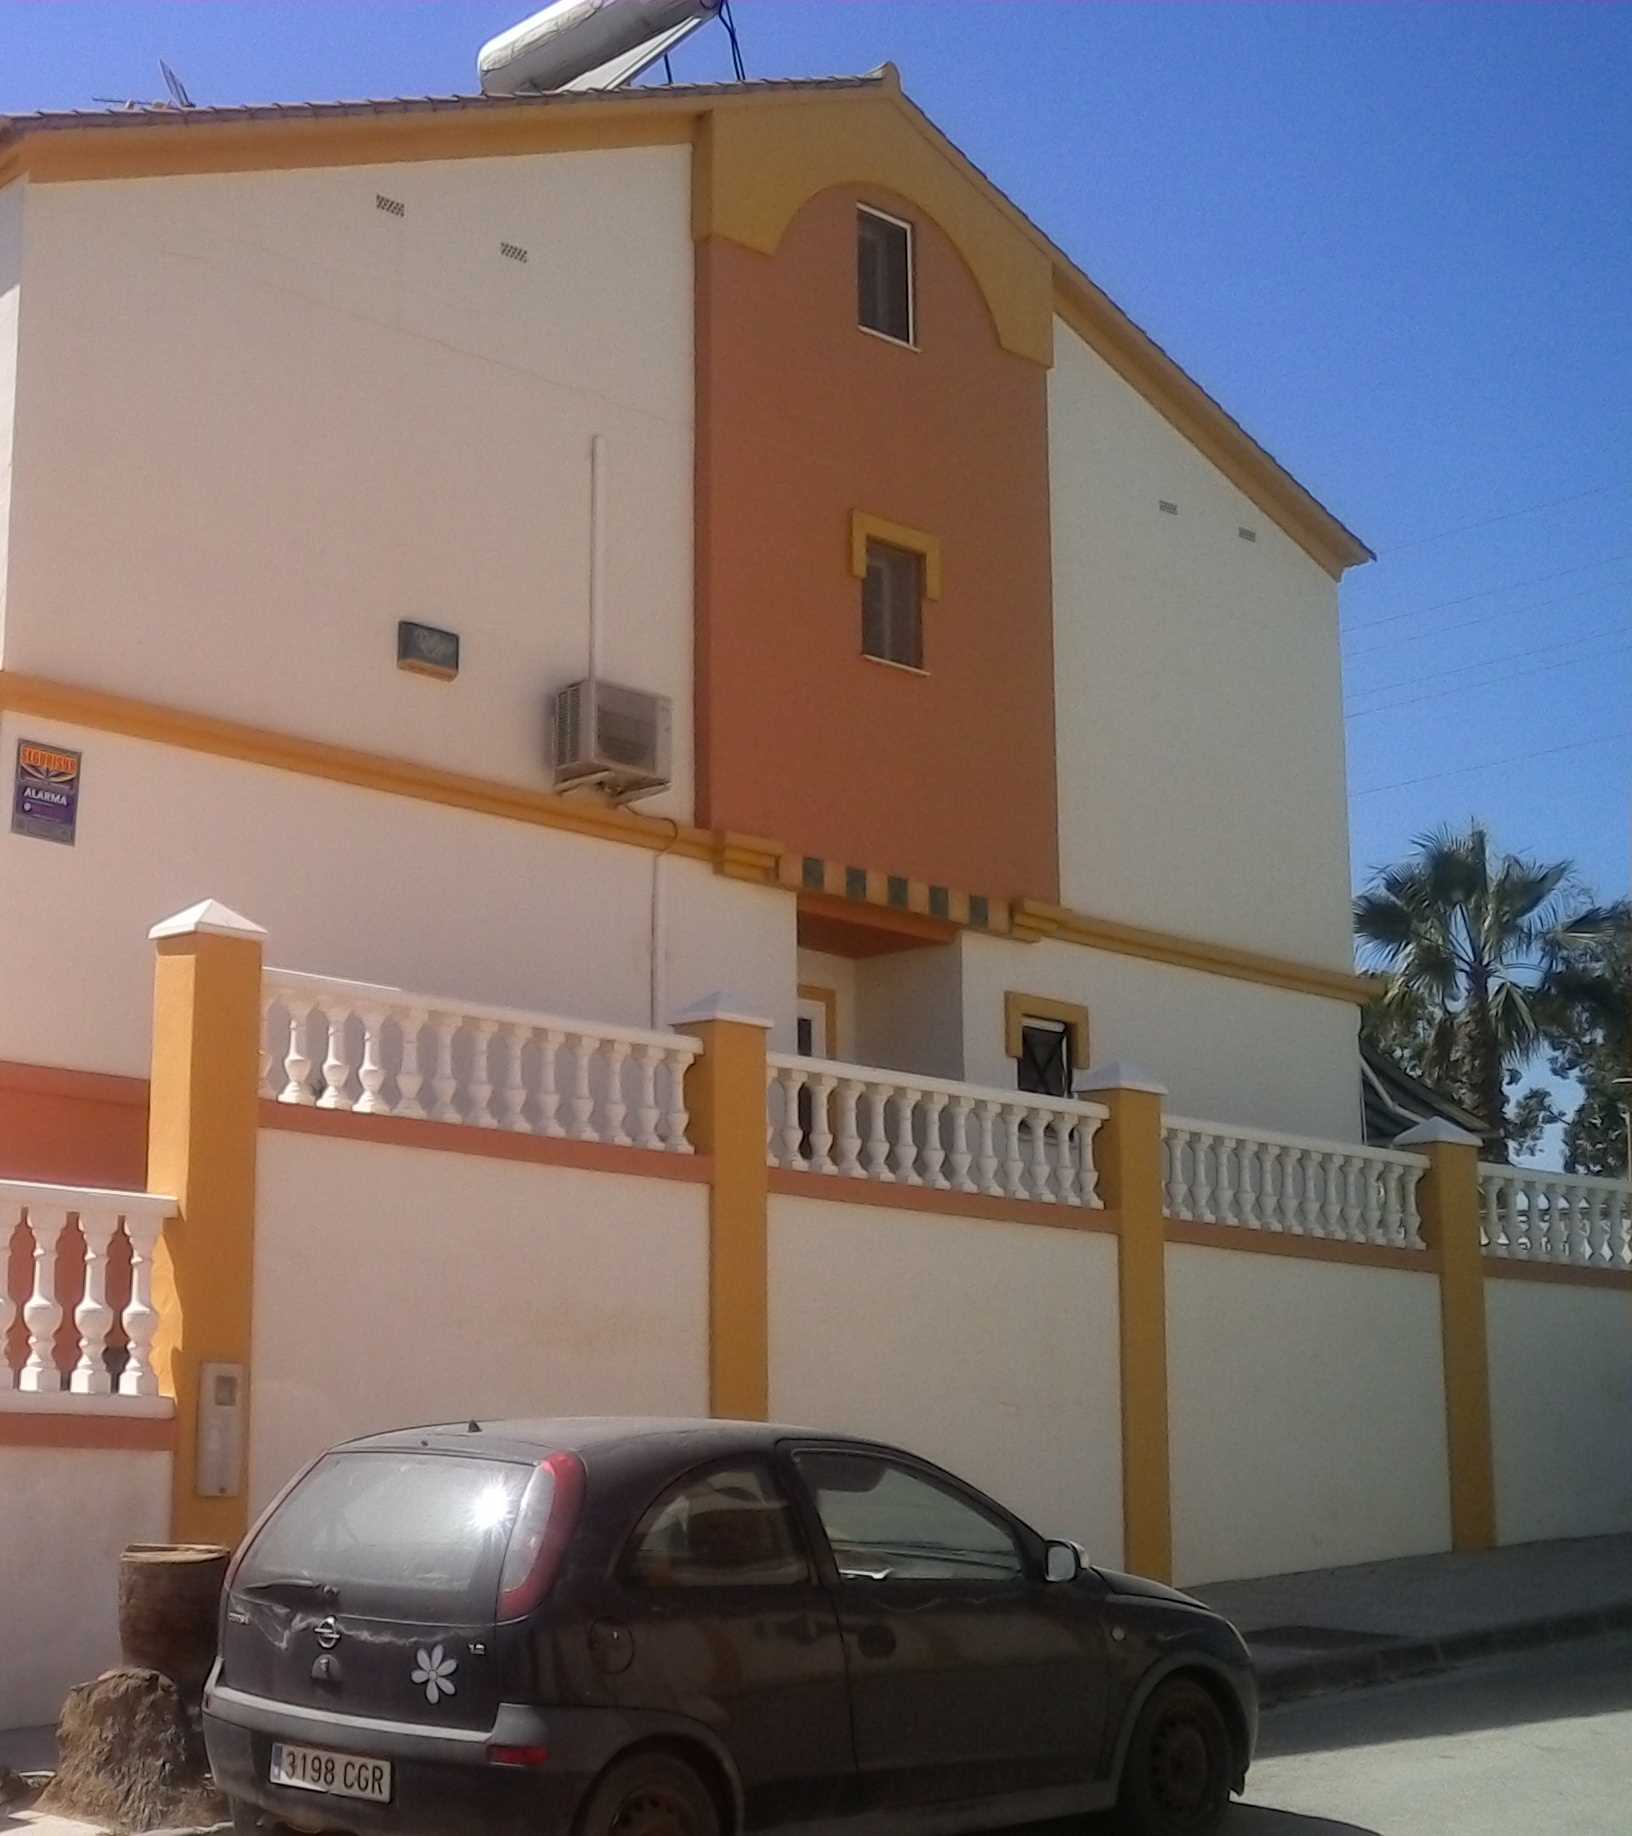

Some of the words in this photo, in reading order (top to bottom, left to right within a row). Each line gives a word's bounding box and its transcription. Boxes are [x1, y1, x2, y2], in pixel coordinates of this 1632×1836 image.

[24, 787, 68, 805] ALARMA
[286, 1752, 335, 1785] 3198
[343, 1761, 384, 1795] CGR
